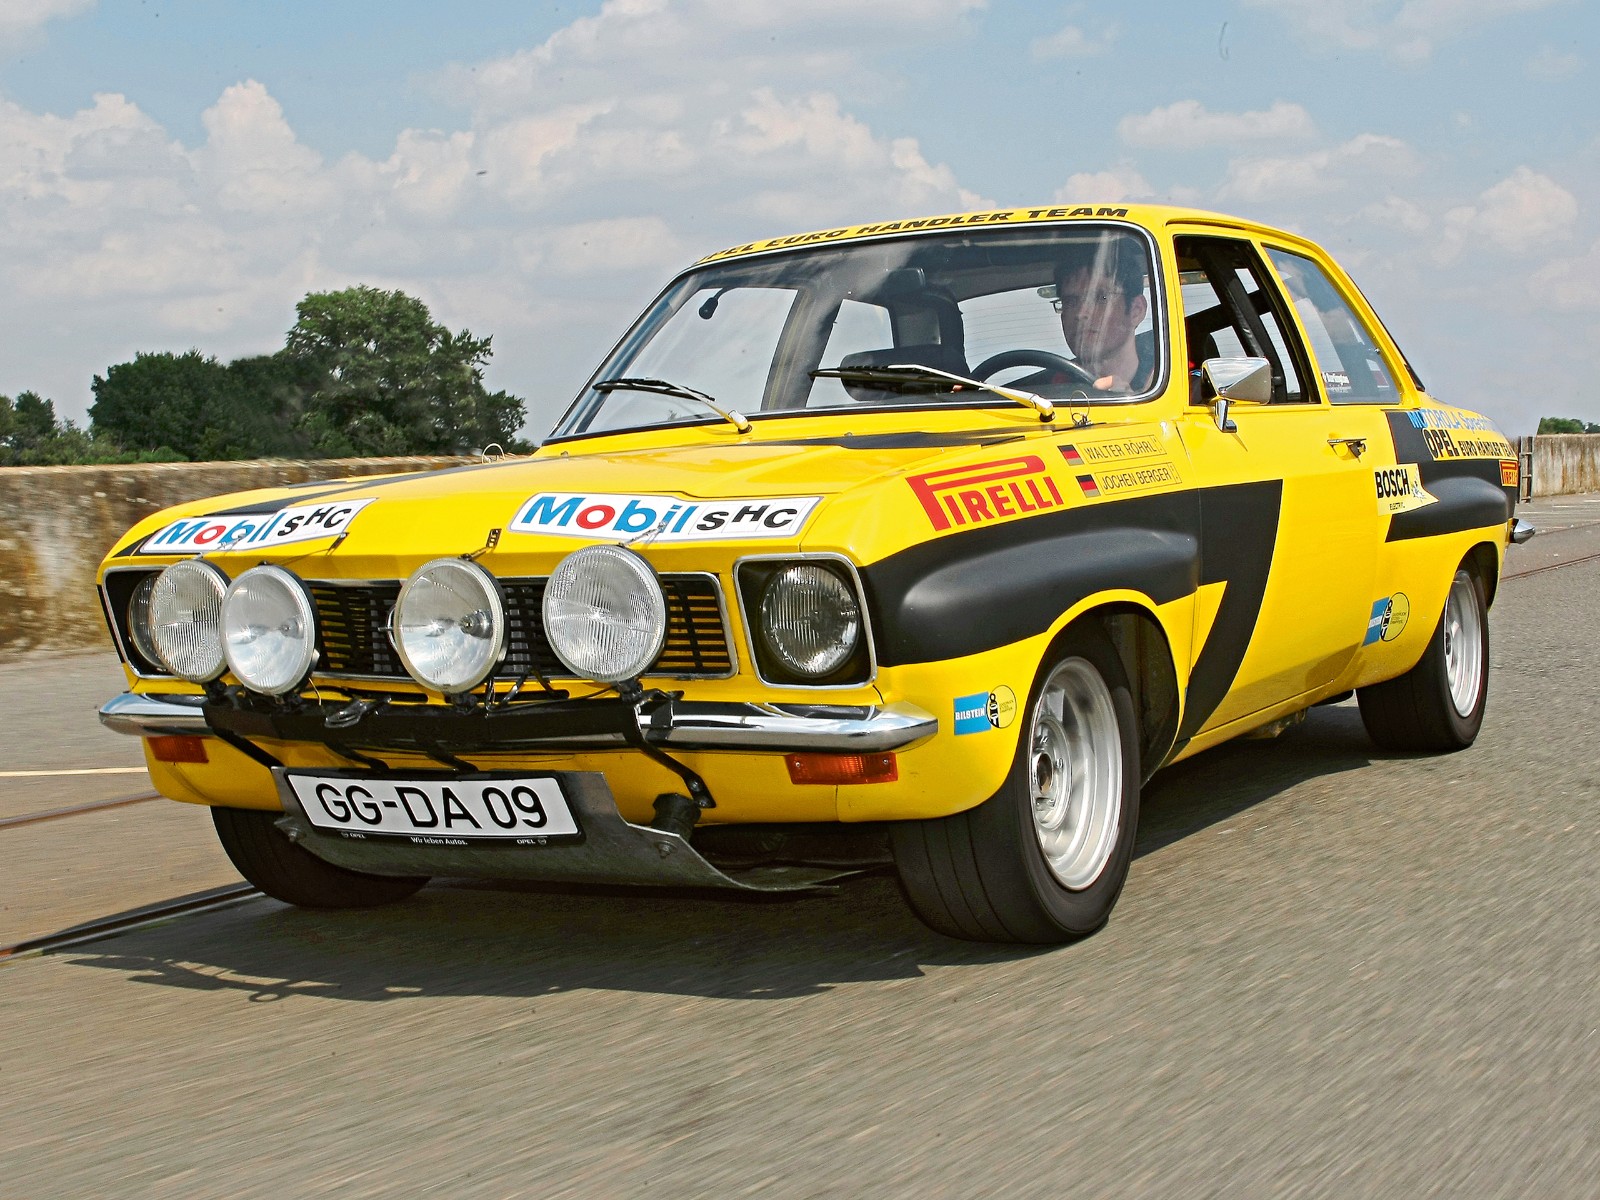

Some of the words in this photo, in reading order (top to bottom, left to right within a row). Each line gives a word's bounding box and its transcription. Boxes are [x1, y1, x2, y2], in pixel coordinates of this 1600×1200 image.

[765, 229, 848, 248] EURO
[856, 211, 1014, 234] HANDLER
[1027, 206, 1129, 219] TEAM
[1407, 408, 1461, 430] MOTOROLA
[1084, 443, 1125, 460] WALTER
[1422, 429, 1460, 459] OPEL
[1458, 440, 1478, 457] EURO
[905, 454, 1065, 531] PIRELLI
[1102, 471, 1138, 490] JOCHEN
[1136, 467, 1172, 485] BERGER
[1374, 468, 1411, 499] BOSCH
[153, 512, 288, 545] Mobil
[520, 496, 699, 534] Mobil
[955, 707, 986, 721] BILSTEIN
[315, 783, 483, 829] GG-DA
[481, 785, 548, 829] 09
